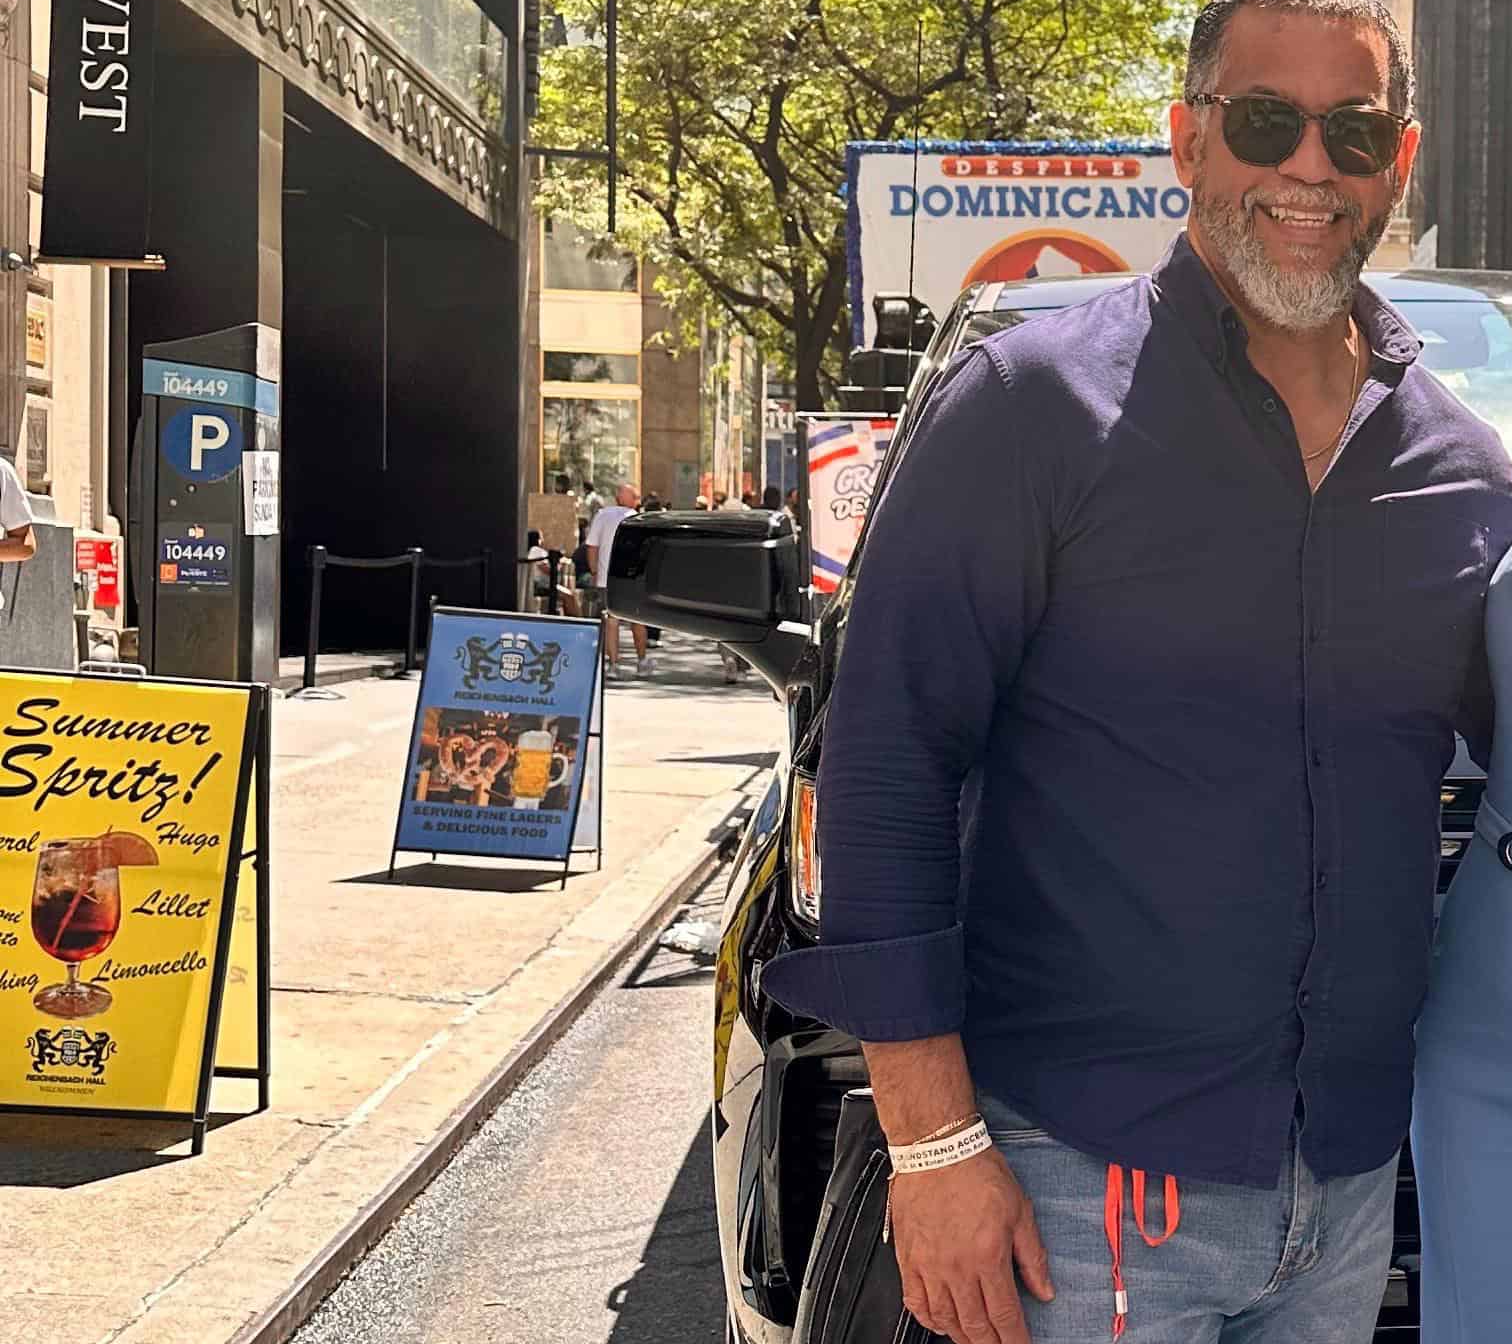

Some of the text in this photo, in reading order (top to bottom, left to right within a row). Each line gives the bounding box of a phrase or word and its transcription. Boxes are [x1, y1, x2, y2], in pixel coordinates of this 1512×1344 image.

[955, 159, 1126, 177] DESFILE
[889, 184, 1190, 219] DOMINICANO
[163, 376, 229, 397] 104449
[190, 414, 230, 471] P
[166, 544, 226, 561] 104449
[3, 698, 212, 746] Summer
[0, 743, 224, 823] Spritz!
[414, 807, 562, 825] SERVING FINE LAGERS
[0, 830, 41, 852] erol
[156, 822, 221, 855] Hugo
[437, 822, 508, 835] DELICIOUS
[511, 826, 548, 839] FOOD
[131, 888, 211, 918] Lillet
[90, 950, 208, 983] Limoncello
[86, 1076, 106, 1085] HALL
